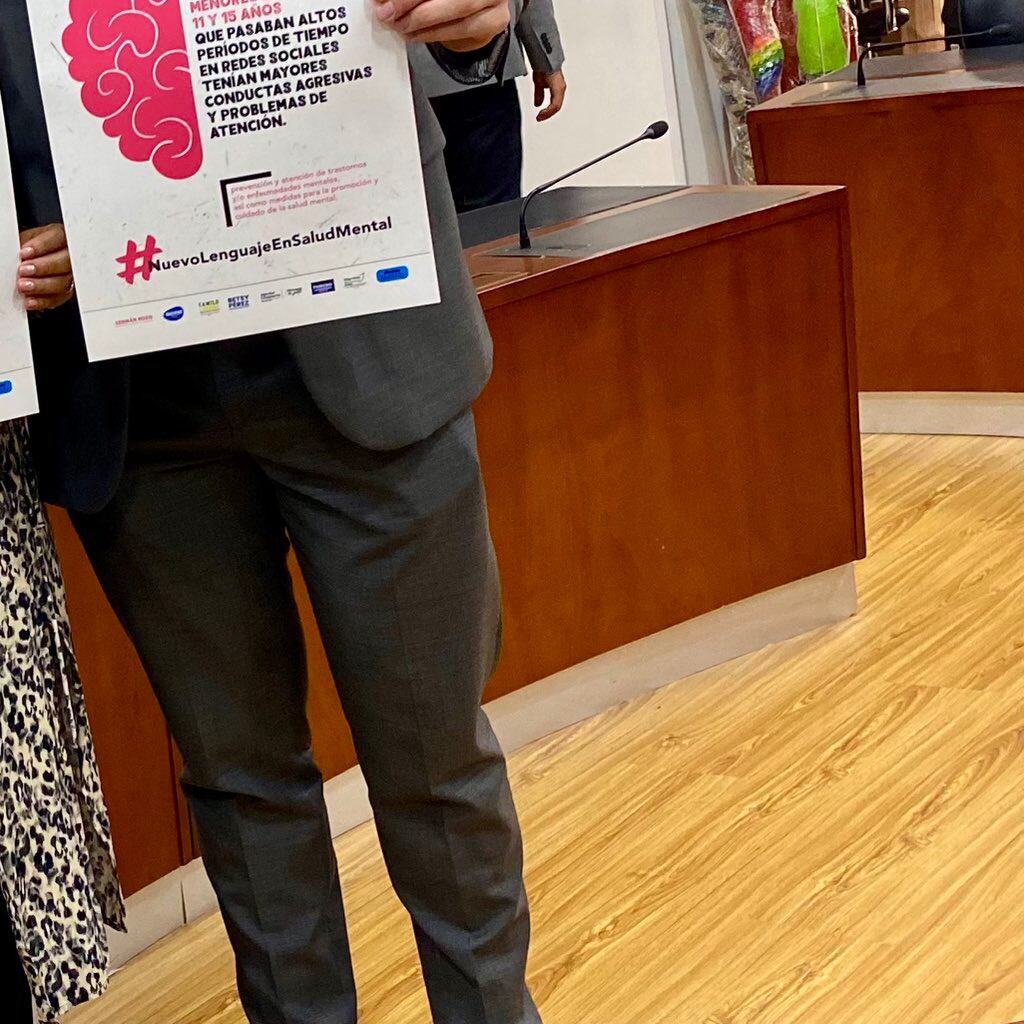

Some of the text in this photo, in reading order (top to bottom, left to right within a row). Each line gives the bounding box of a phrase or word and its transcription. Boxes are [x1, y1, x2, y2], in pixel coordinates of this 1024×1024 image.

[192, 2, 282, 29] 11 Y 15 AÑOS
[195, 7, 346, 44] QUE PASABAN ALTOS
[197, 23, 349, 61] PERÍODOS DE TIEMPO
[199, 41, 339, 77] EN REDES SOCIALES
[202, 59, 327, 92] TENÍAN MAYORES
[204, 66, 372, 108] CONDUCTAS AGRESIVAS
[207, 90, 328, 123] Y PROBLEMAS DE
[210, 114, 287, 139] ATENCIÓN.
[114, 216, 393, 286] #NuevoLenguajeEnSaludMental
